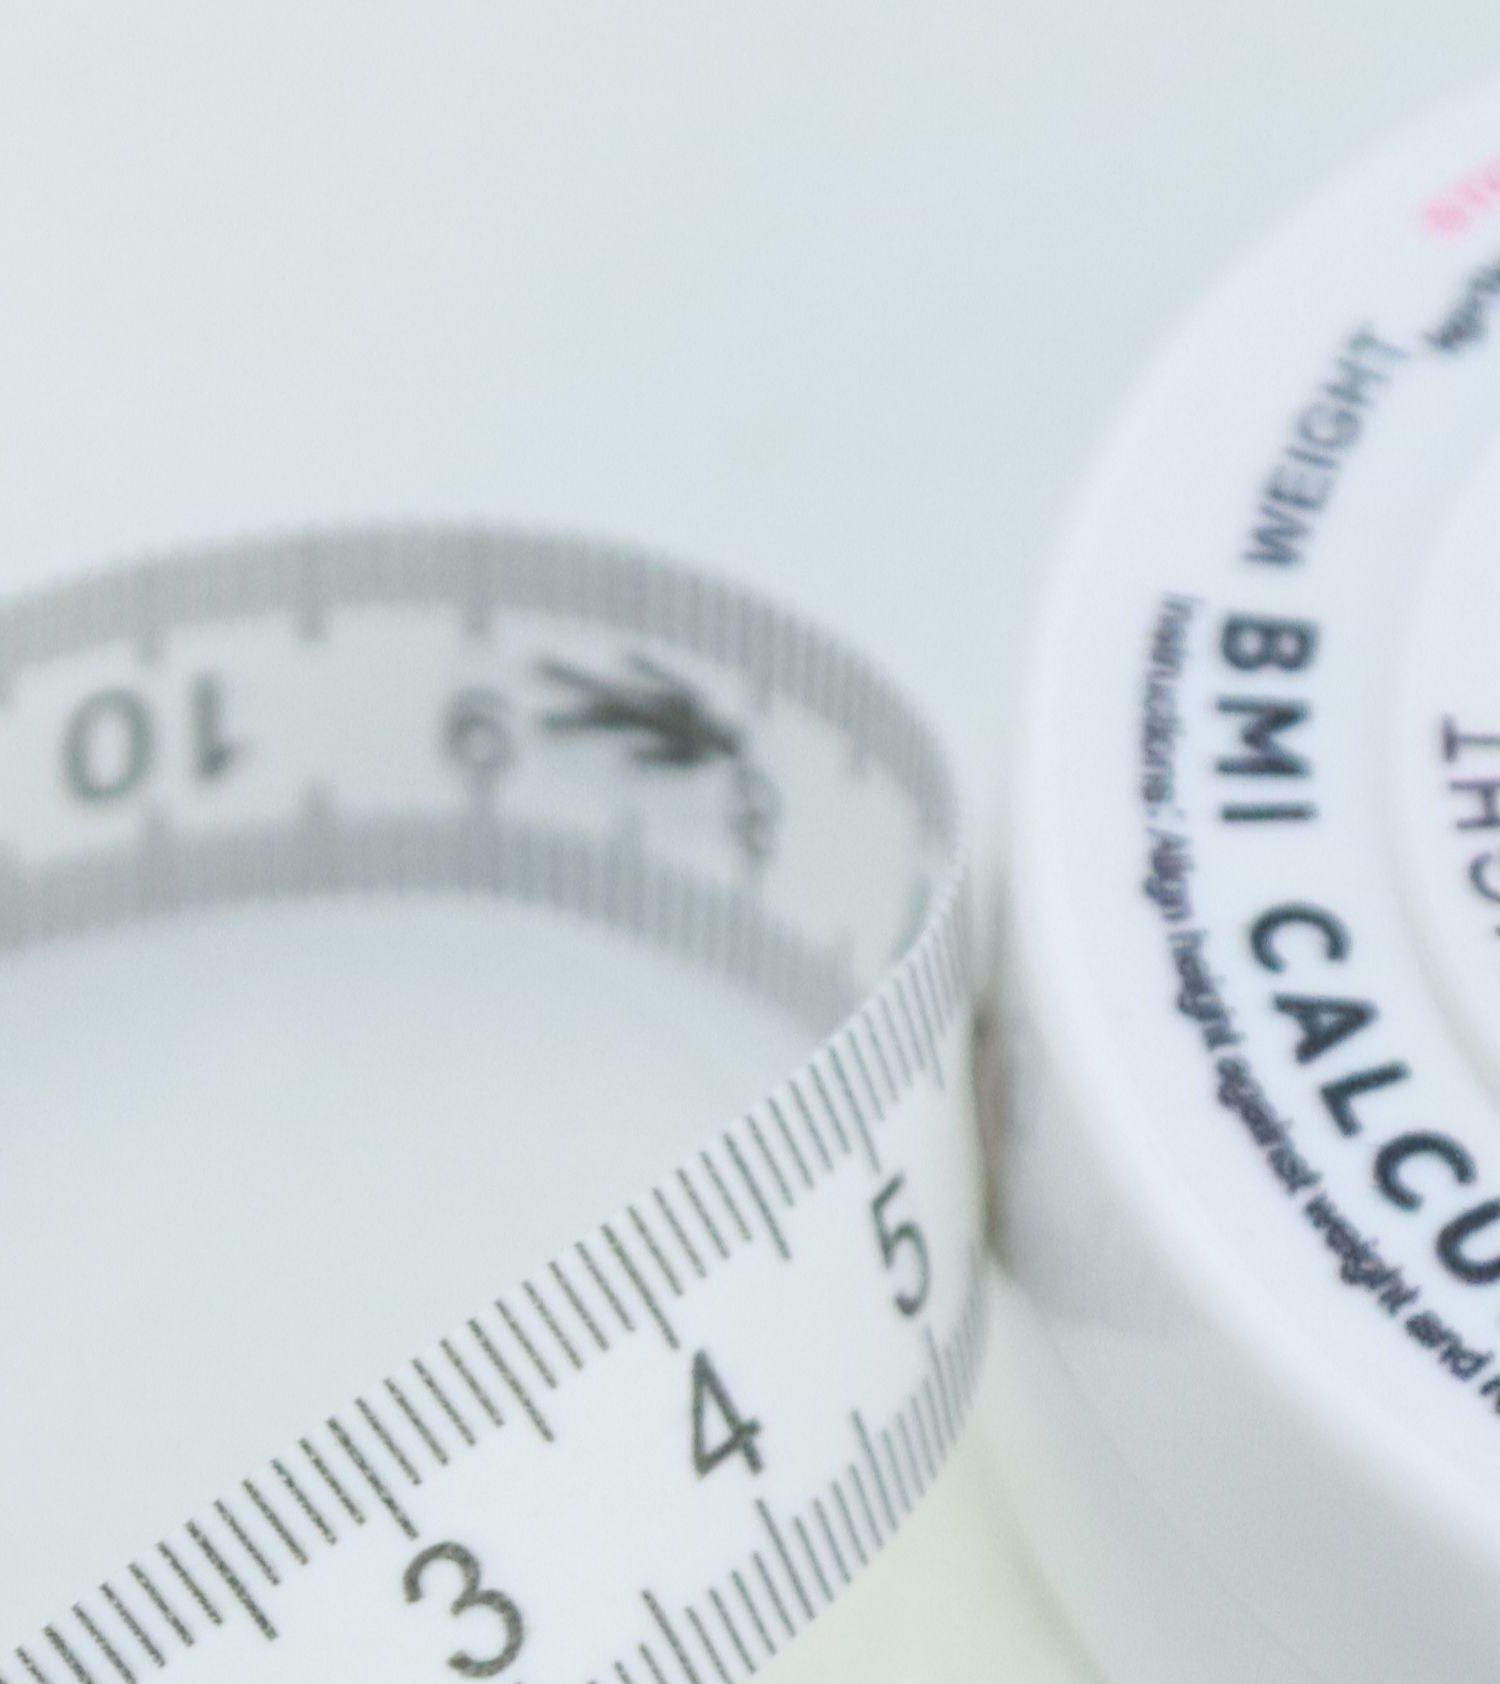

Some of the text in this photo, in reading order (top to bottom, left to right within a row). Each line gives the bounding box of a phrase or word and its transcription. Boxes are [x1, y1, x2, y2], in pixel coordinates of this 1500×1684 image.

[1242, 322, 1412, 570] WEIGHT
[66, 680, 240, 803] 10
[1217, 613, 1322, 824] BMI
[1144, 824, 1196, 926] Align
[1168, 929, 1246, 1055] height
[1212, 1055, 1318, 1196] against
[1302, 1180, 1418, 1316] weight
[1407, 1308, 1491, 1383] and
[400, 1537, 530, 1683] 3
[685, 1344, 765, 1484] 4
[868, 1175, 933, 1318] 5
